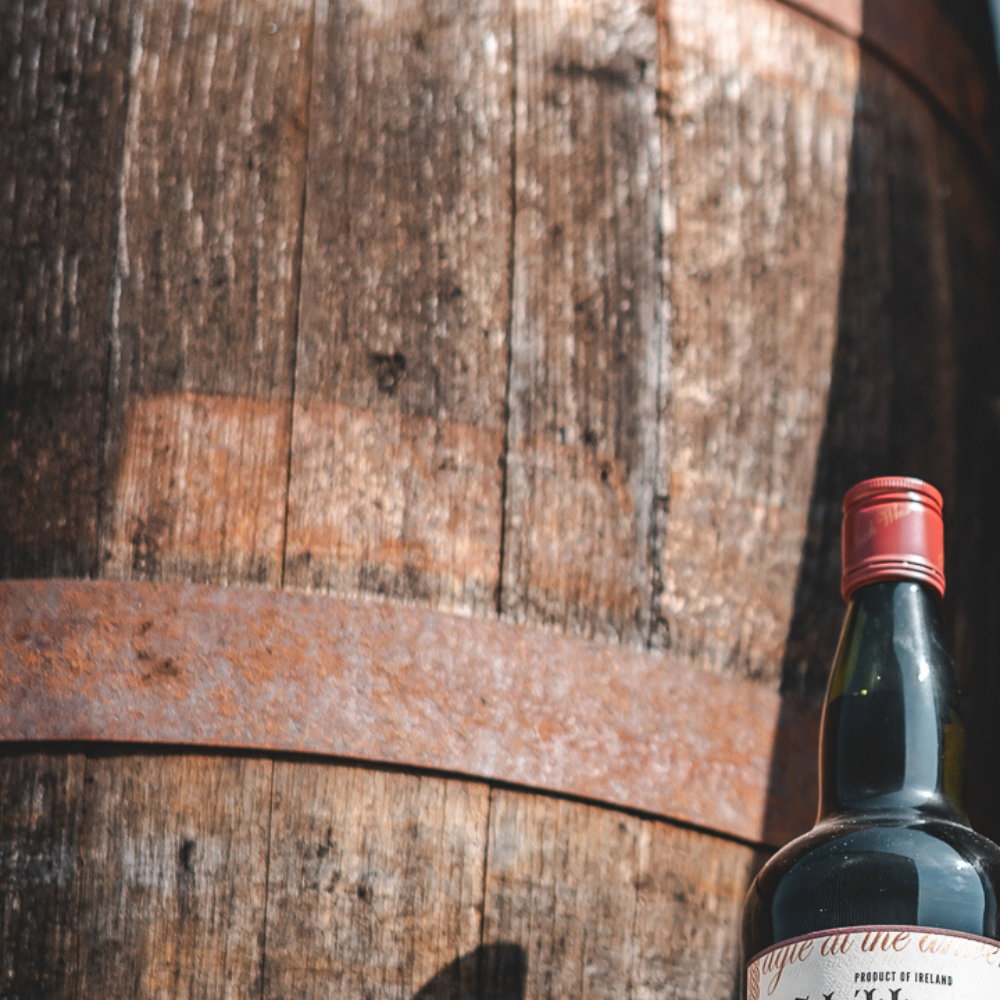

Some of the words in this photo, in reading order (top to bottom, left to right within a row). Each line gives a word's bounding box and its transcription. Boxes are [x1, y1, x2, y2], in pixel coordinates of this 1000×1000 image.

[854, 971, 897, 983] PRODUCT
[900, 971, 911, 983] OF
[914, 972, 954, 987] IRELAND
